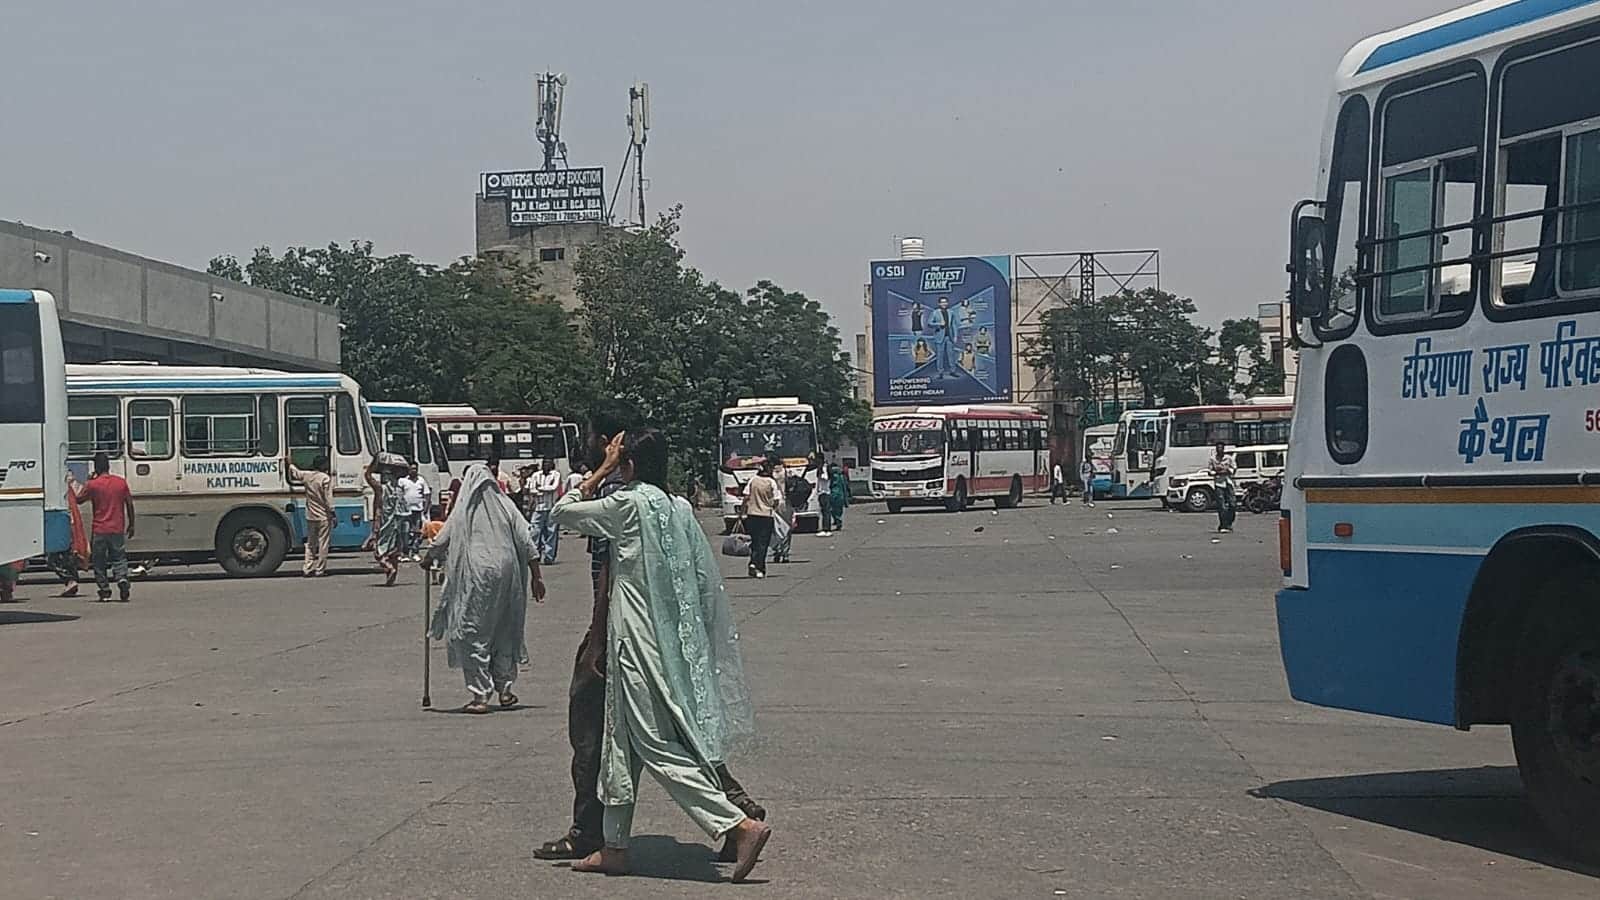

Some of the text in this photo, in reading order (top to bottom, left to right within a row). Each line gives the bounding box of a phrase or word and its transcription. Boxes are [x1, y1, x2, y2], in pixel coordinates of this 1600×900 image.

[501, 170, 601, 187] UNIVERSAL GROUP OF EDUCATION
[886, 265, 905, 277] SBI
[925, 270, 961, 281] COOLEST
[924, 280, 947, 290] BANK
[1402, 337, 1473, 398] हरियाणा
[1482, 344, 1530, 393] राज्य
[889, 377, 931, 385] EMPOWERING
[727, 413, 807, 425] SHIRA
[878, 420, 938, 430] SHIRA
[1458, 396, 1550, 463] कैथल
[9, 460, 36, 471] PRO
[184, 462, 278, 474] HARYANA ROADWAYS
[207, 477, 260, 488] KAITHAL
